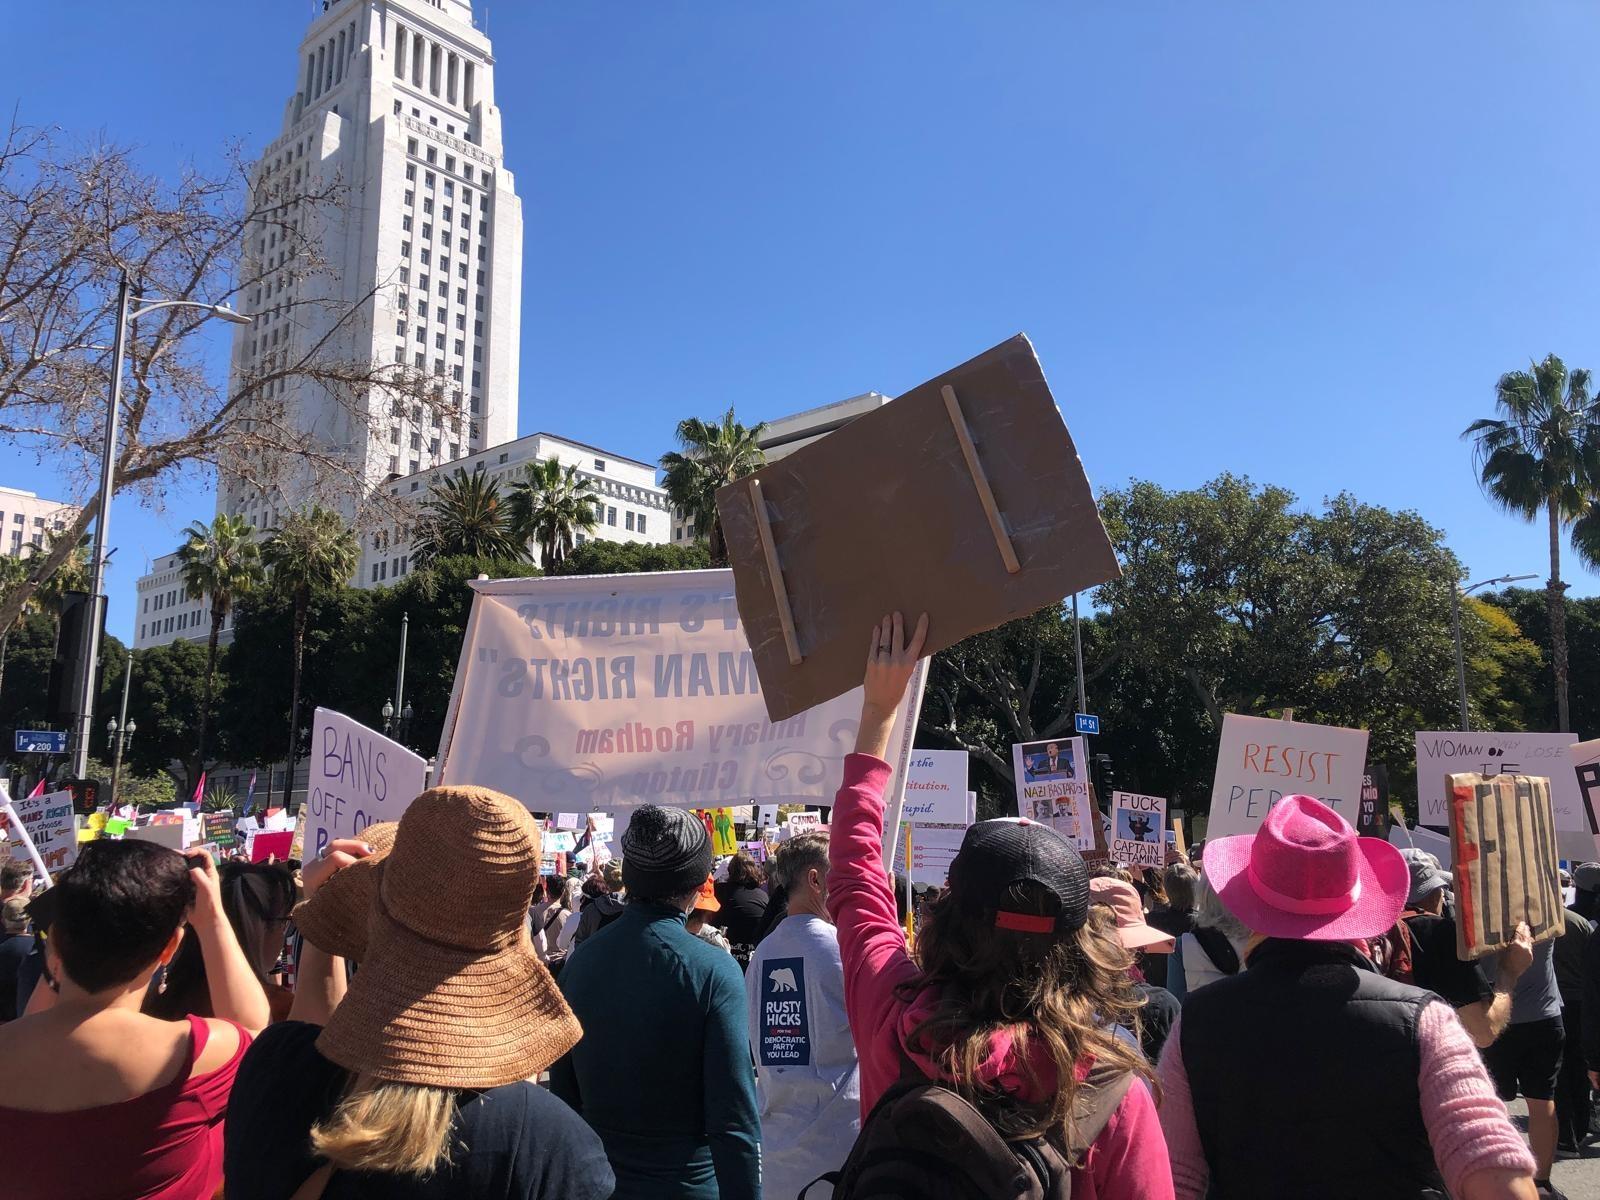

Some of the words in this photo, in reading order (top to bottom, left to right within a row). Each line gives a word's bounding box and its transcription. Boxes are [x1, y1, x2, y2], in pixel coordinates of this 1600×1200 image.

[1088, 719, 1095, 730] St
[36, 742, 52, 751] 200
[1422, 739, 1483, 758] WOMAN
[1525, 747, 1564, 758] LOSE
[323, 726, 388, 802] BANS
[917, 757, 934, 768] the
[1244, 743, 1342, 784] RESIST
[1480, 763, 1521, 774] IF
[905, 781, 950, 791] titution,
[1024, 785, 1046, 799] NAZI
[20, 800, 39, 811] It's
[45, 797, 51, 805] a
[311, 787, 346, 829] OFF
[902, 803, 934, 816] tupid.
[1120, 794, 1160, 812] FUCK
[1363, 801, 1374, 813] YO
[37, 820, 63, 831] choose
[33, 830, 53, 845] AIL
[1114, 840, 1159, 856] CAPTAIN
[1112, 851, 1163, 866] KETAMINE
[766, 1001, 801, 1014] RUSTY
[766, 1013, 801, 1026] HICKS
[765, 1036, 806, 1044] DEMOCRATIC
[781, 1050, 800, 1058] LEAD
